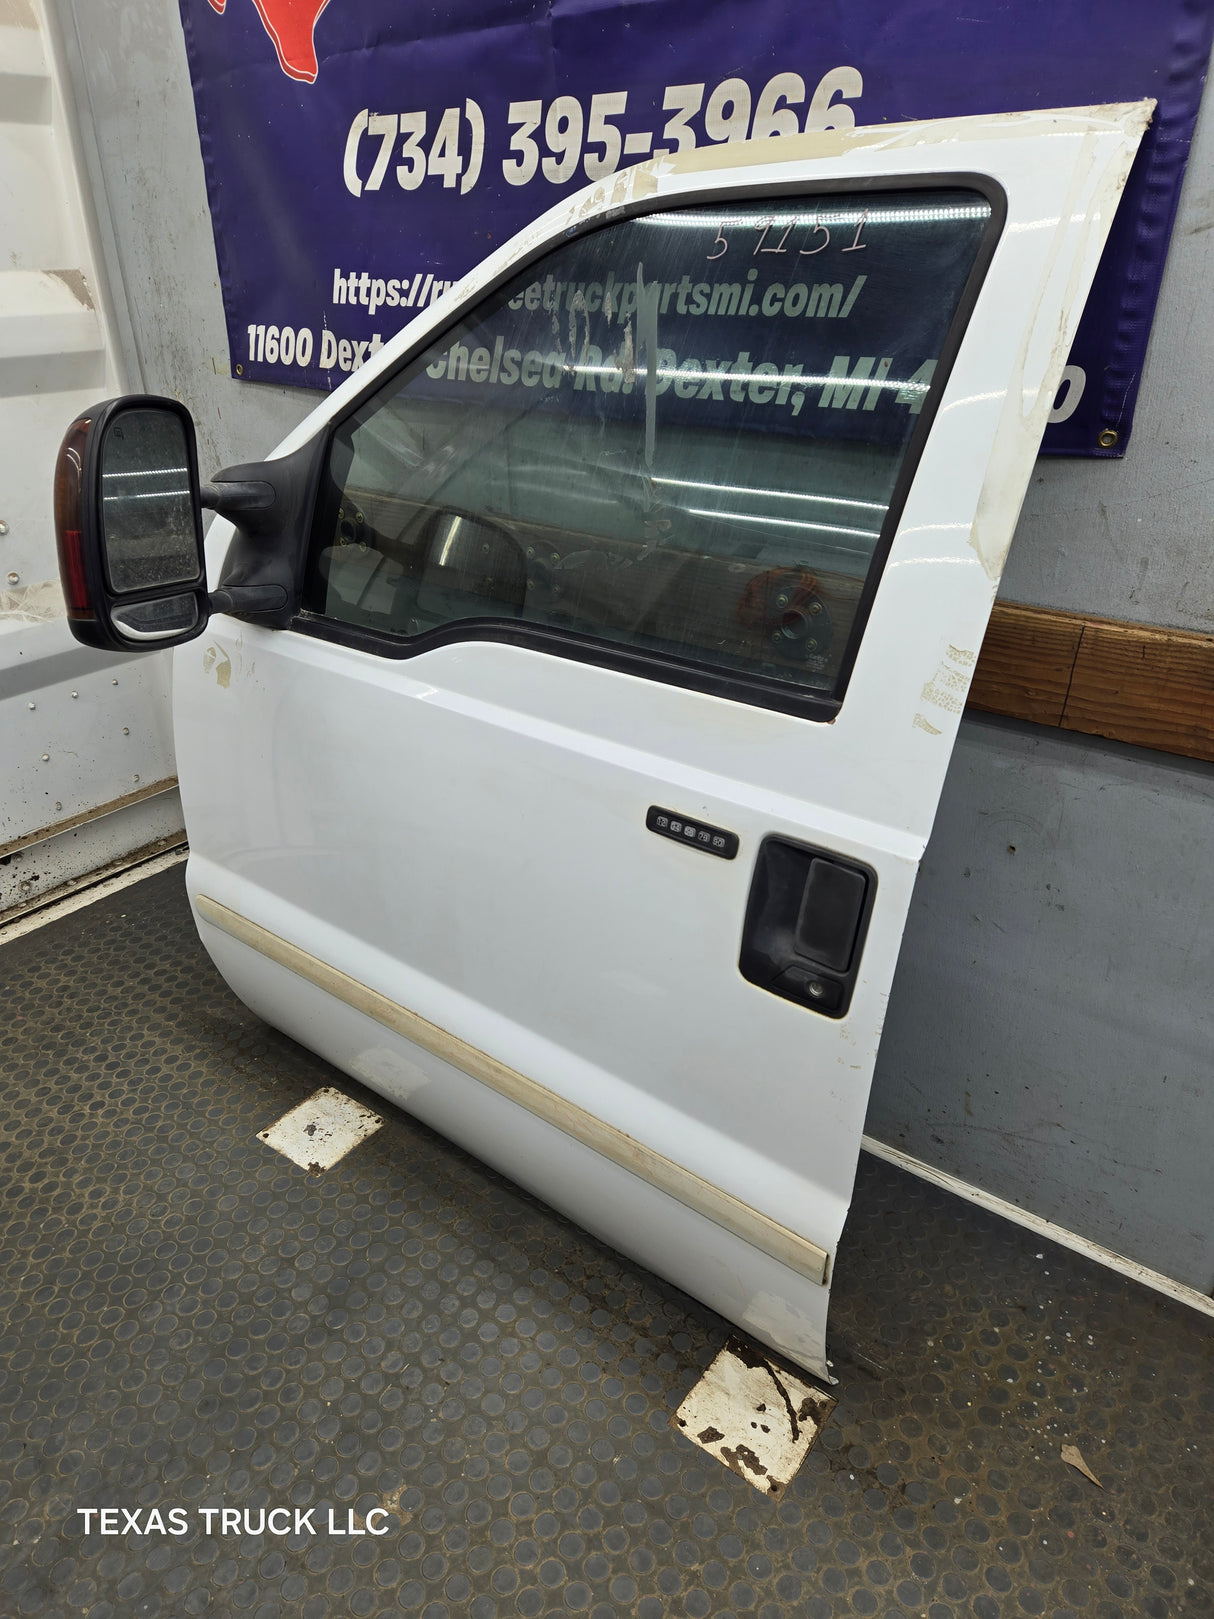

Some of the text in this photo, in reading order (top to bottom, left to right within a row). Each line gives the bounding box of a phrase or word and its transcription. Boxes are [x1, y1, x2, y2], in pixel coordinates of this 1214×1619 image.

[343, 66, 864, 198] (734) 395-3966
[247, 324, 314, 367] 11600
[319, 329, 386, 373] Dext
[645, 347, 805, 416] Dexter,
[818, 356, 893, 412] MI
